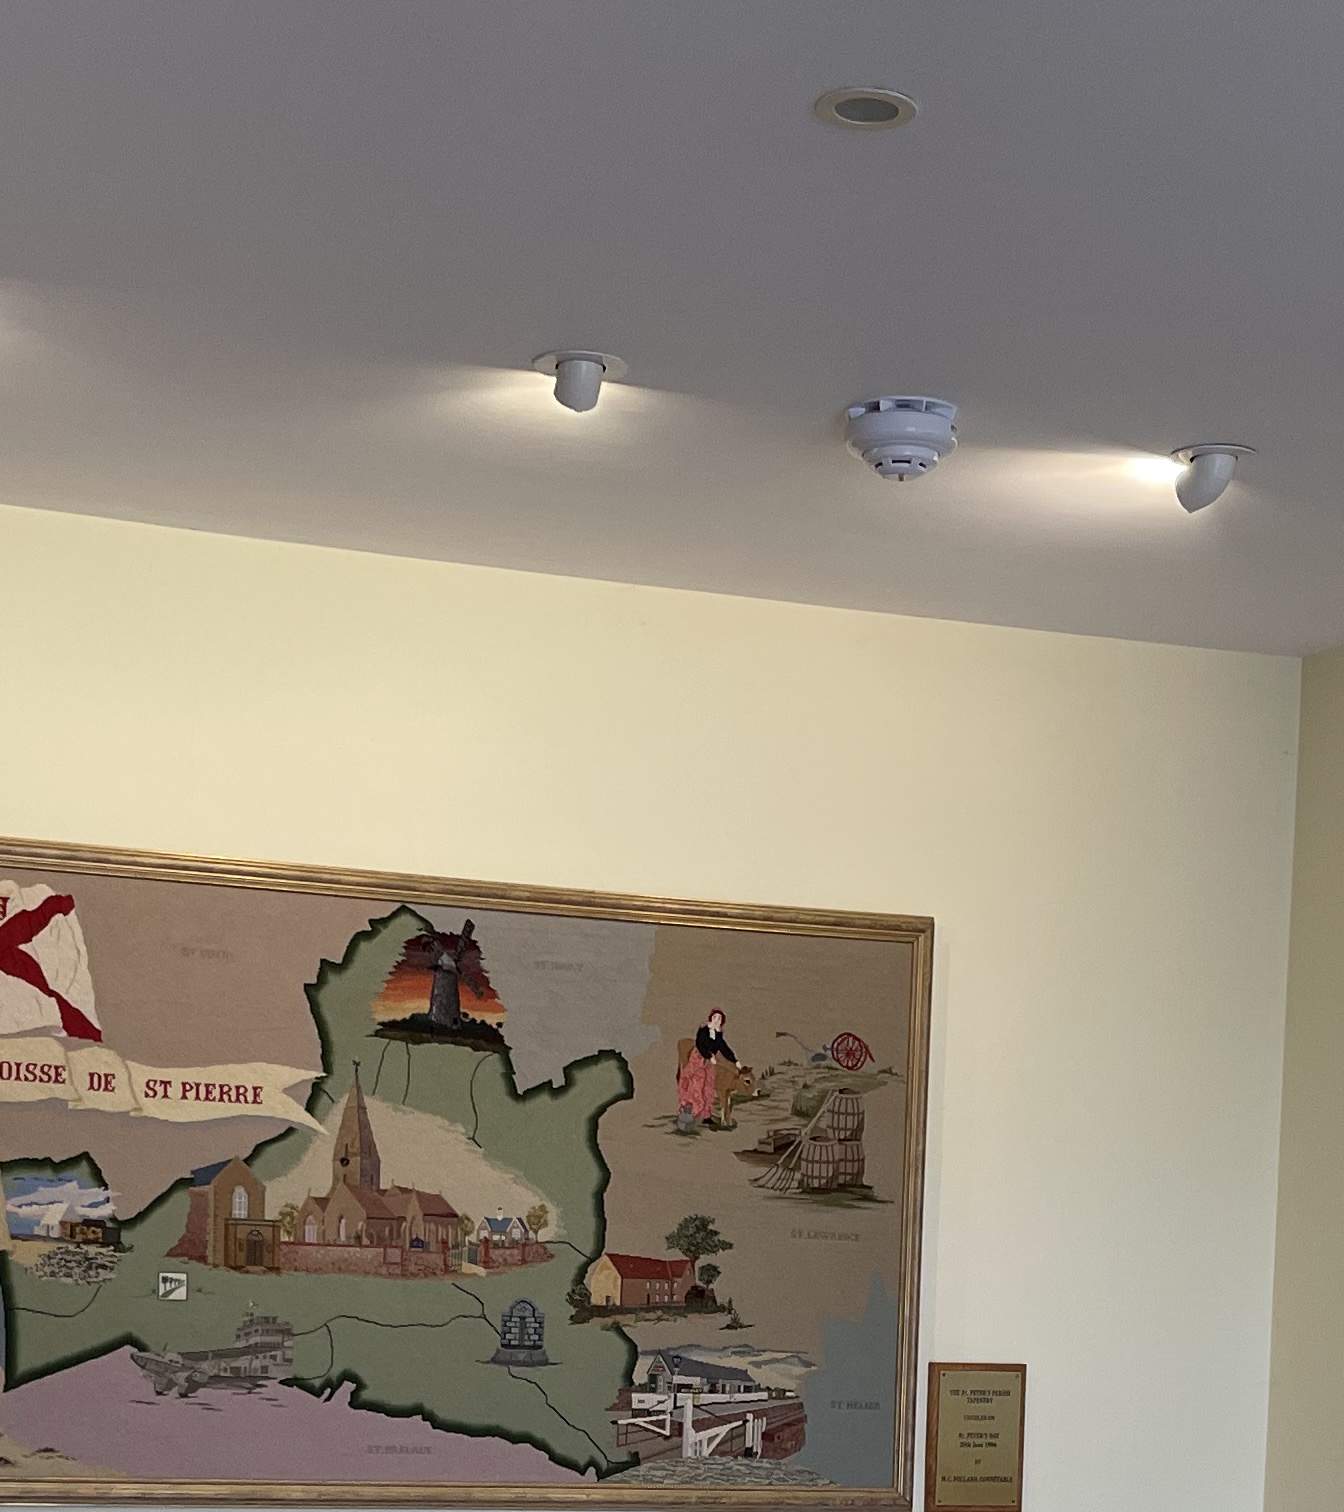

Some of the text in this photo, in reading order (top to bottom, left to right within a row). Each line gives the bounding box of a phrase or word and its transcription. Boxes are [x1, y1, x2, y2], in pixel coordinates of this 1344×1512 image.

[88, 1071, 116, 1093] DE
[143, 1078, 172, 1099] ST
[180, 1081, 264, 1105] PIERRE
